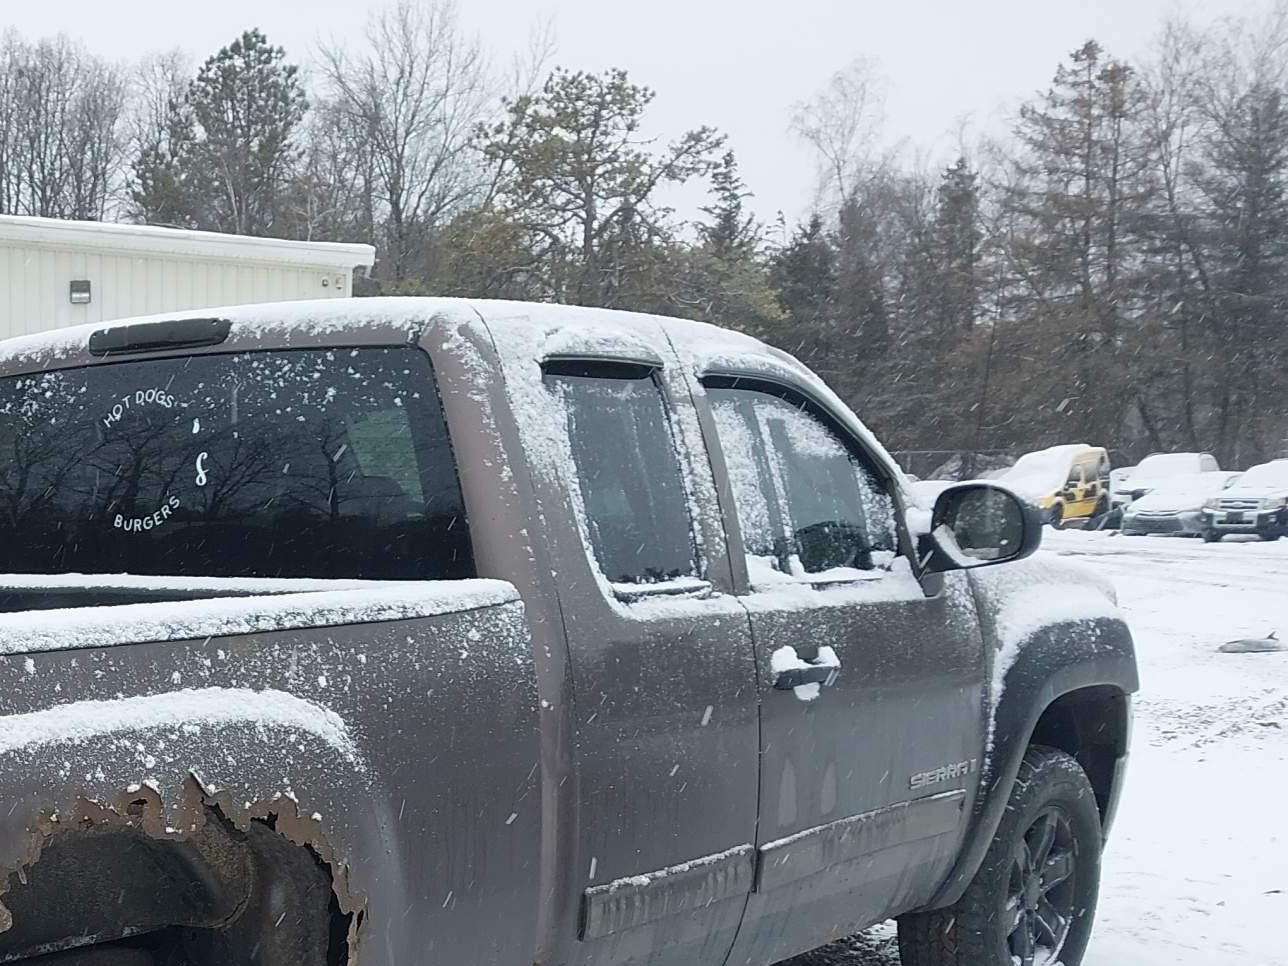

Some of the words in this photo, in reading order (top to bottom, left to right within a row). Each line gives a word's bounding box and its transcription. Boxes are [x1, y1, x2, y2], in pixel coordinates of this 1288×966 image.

[103, 395, 131, 428] HOT
[135, 389, 175, 408] DOGS
[113, 495, 180, 532] BURGERS
[910, 760, 968, 790] SIERRA
